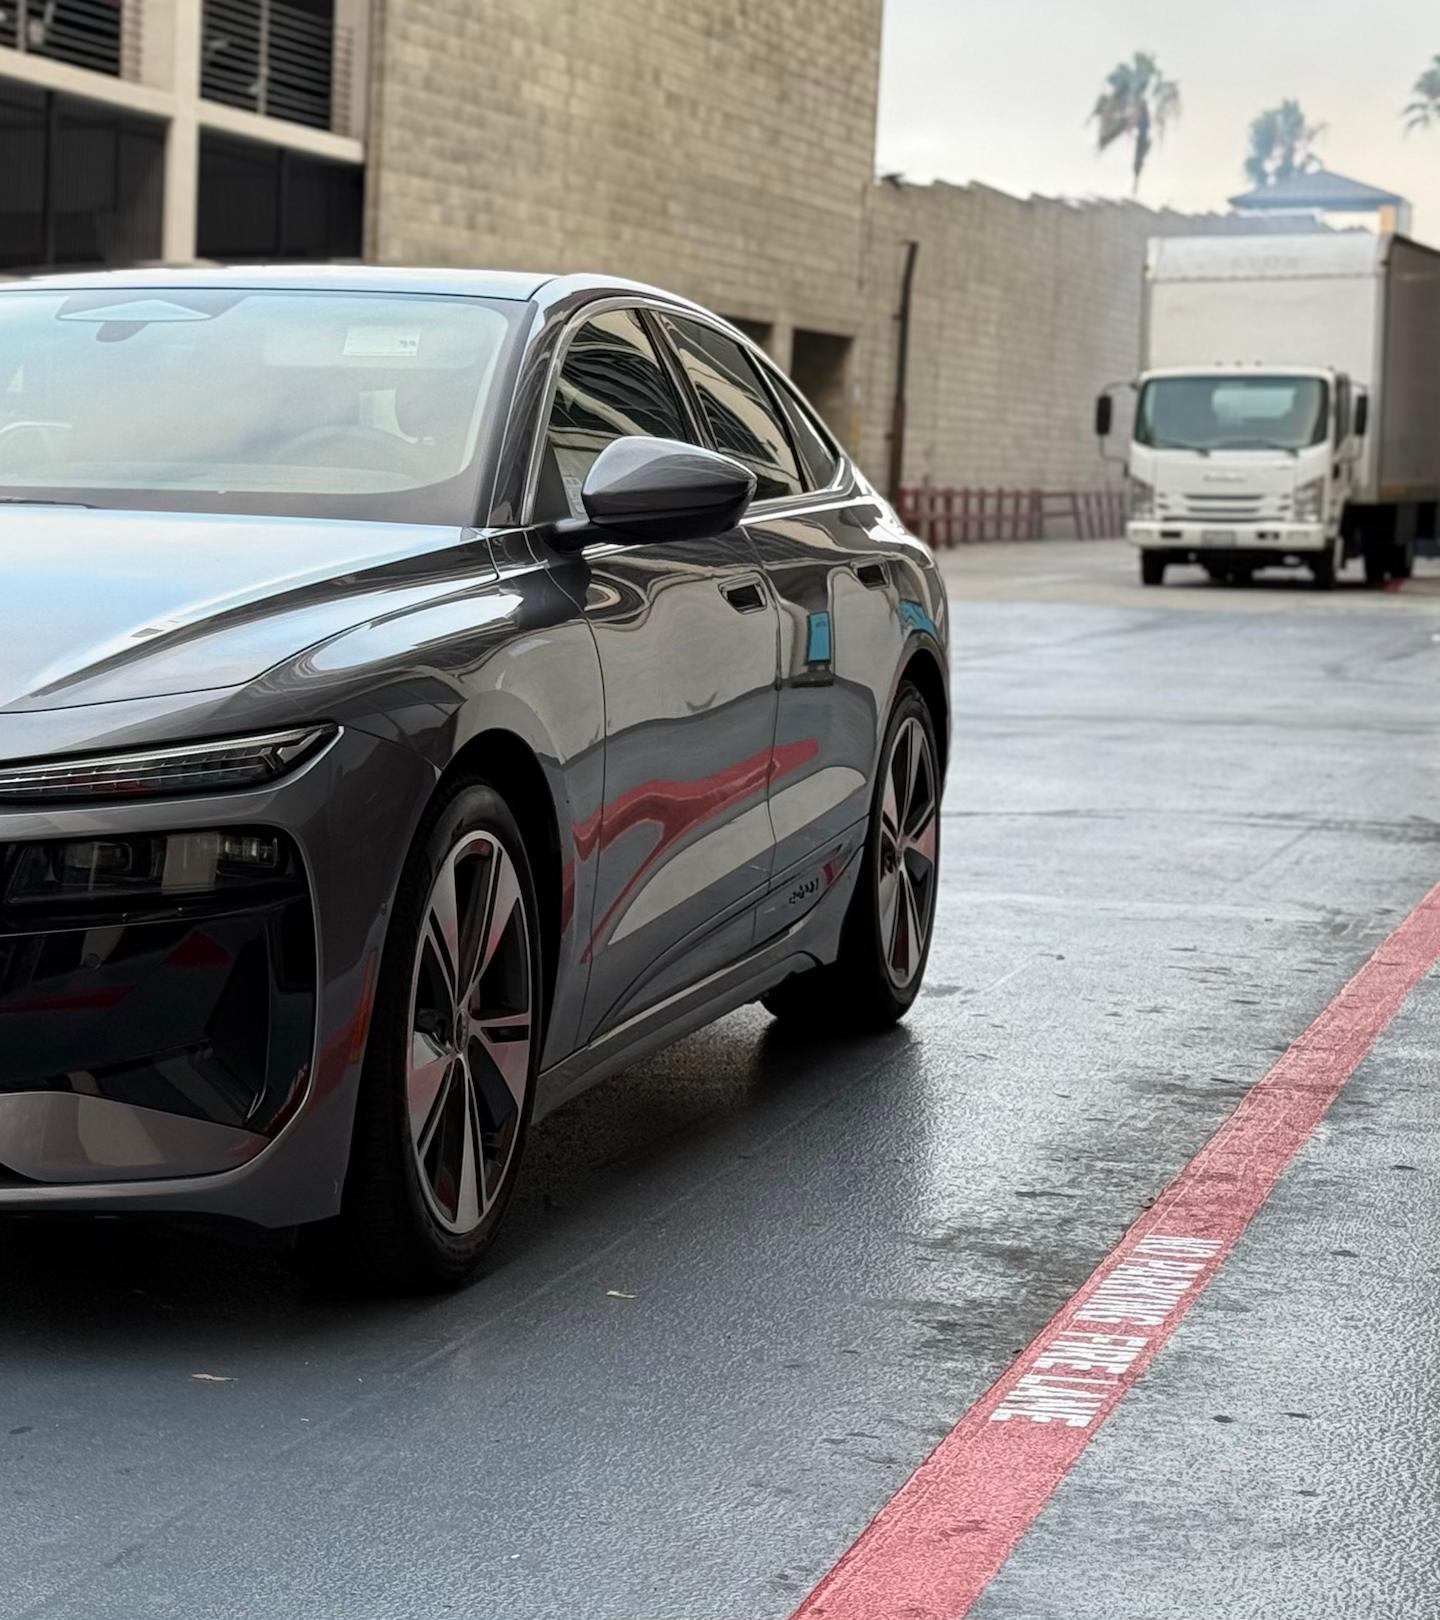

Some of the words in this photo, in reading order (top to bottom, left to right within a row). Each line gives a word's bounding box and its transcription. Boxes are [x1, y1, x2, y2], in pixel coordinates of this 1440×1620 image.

[1134, 1234, 1224, 1258] NO
[1072, 1258, 1208, 1325] PARKING
[1032, 1331, 1148, 1374] FIRE
[990, 1374, 1118, 1428] LANE
